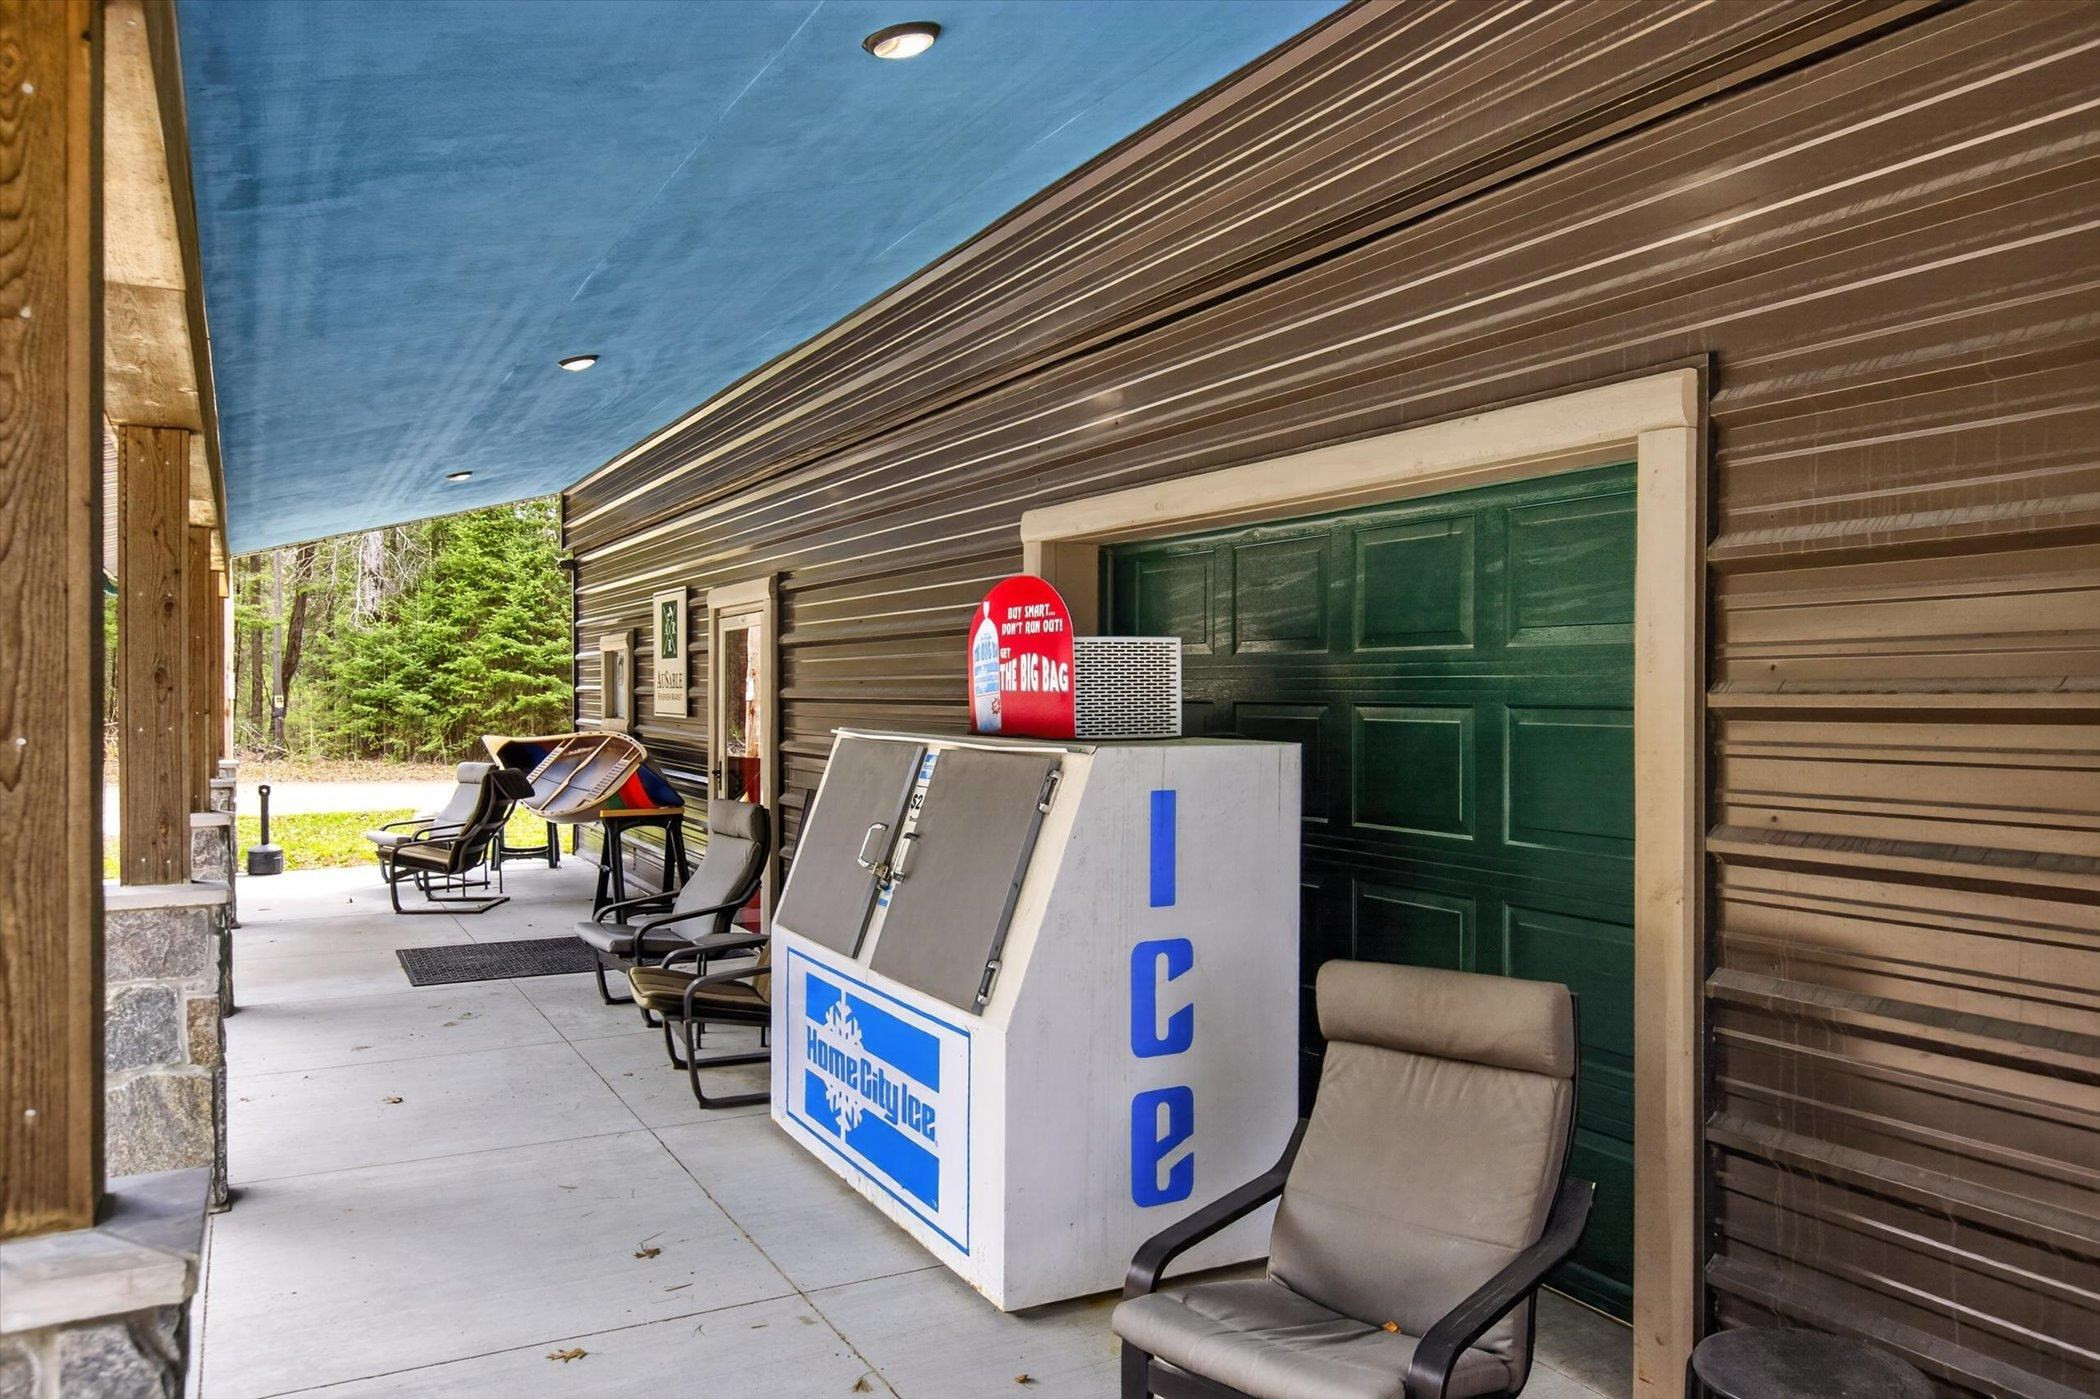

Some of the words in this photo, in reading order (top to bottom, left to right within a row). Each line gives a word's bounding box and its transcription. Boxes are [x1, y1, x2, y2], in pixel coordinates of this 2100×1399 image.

[1007, 606, 1022, 620] BUY
[1024, 604, 1056, 619] SMART...
[1001, 622, 1023, 636] DON'T
[1025, 620, 1041, 635] RUN
[1043, 618, 1063, 633] OUT!
[1000, 647, 1011, 659] GET
[1000, 657, 1018, 691] THE
[1020, 652, 1039, 692] BIG
[1041, 656, 1069, 692] BAG
[1131, 790, 1194, 1208] Ice
[806, 1025, 858, 1091] Home
[860, 1057, 899, 1126] City
[902, 1082, 936, 1142] Ice
